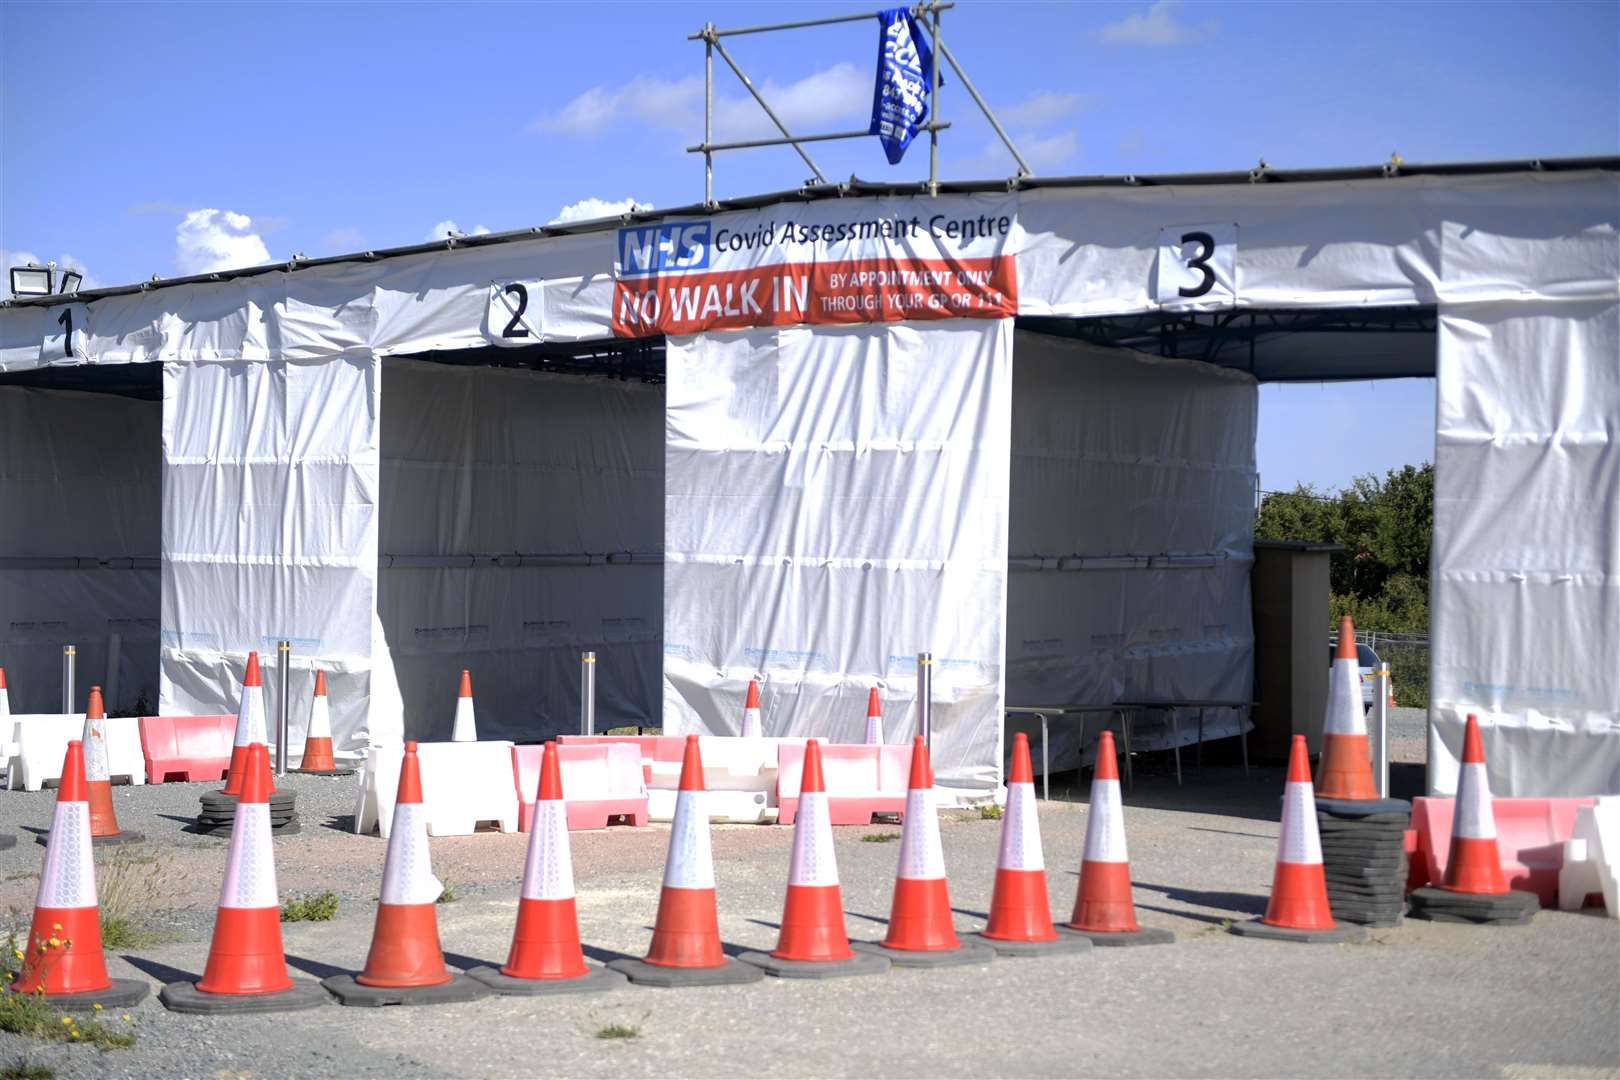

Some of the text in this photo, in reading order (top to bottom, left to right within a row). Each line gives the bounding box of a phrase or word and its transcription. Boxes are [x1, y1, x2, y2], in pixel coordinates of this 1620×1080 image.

[624, 214, 1010, 271] NHS Covid Assessment Centre
[1179, 231, 1216, 297] 3
[619, 275, 808, 326] NO WALK IN
[820, 292, 1002, 312] THROUGH YOUR GP OR 111
[830, 270, 993, 289] BY APPOINTMENT ONLY
[58, 308, 73, 357] 1
[502, 283, 528, 338] 2
